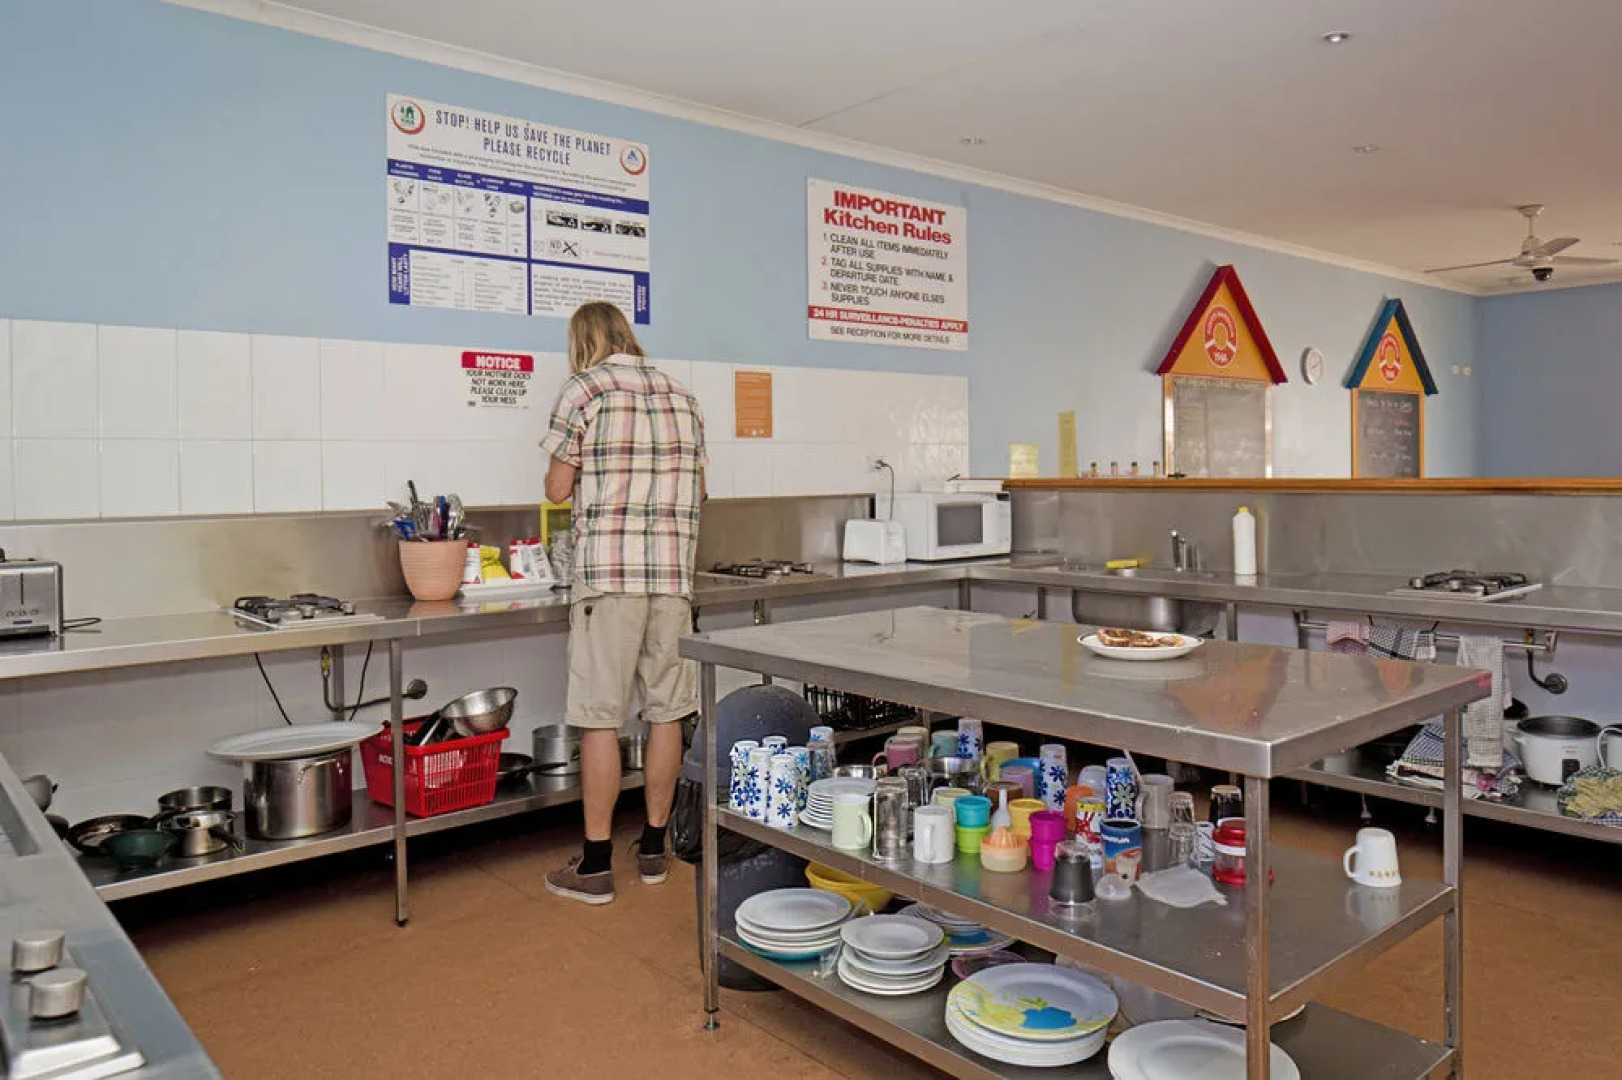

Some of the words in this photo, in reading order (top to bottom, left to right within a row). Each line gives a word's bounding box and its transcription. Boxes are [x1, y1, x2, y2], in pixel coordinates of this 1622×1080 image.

[436, 110, 469, 129] STOP!
[474, 116, 500, 134] HELP
[506, 123, 519, 138] US
[524, 128, 548, 144] SAVE
[554, 132, 571, 148] THE
[576, 137, 610, 156] PLANET
[484, 137, 521, 157] PLEASE
[526, 146, 570, 166] RECYCLE
[834, 190, 946, 226] IMPORTANT
[824, 208, 899, 236] Kitchen
[903, 222, 952, 244] Rules
[830, 234, 858, 246] CLEAN
[860, 239, 874, 249] ALL
[876, 241, 900, 252] ITEMS
[902, 245, 948, 260] IMMEDIATELY
[830, 244, 857, 258] AFTER
[830, 268, 876, 282] DEPARTURE
[831, 258, 846, 268] TAG
[849, 260, 864, 270] ALL
[866, 262, 902, 276] SUPPLIES
[905, 268, 923, 278] WITH
[924, 270, 946, 282] NAME
[948, 274, 954, 282] &
[830, 282, 858, 294] NEVER
[860, 285, 888, 296] TOUCH
[890, 288, 920, 300] ANYONE
[922, 292, 944, 304] ELSES
[831, 294, 870, 306] SUPPLIES
[813, 308, 824, 318] 24
[826, 309, 838, 320] HR
[940, 320, 964, 330] APPLY
[830, 326, 845, 334] SEE
[846, 327, 886, 338] RECEPTION
[887, 330, 901, 339] FOR
[903, 332, 922, 342] MORE
[924, 334, 950, 344] DETAILS
[476, 354, 521, 370] NOTICE
[470, 386, 494, 394] PLEASE
[496, 388, 516, 396] CLEAN
